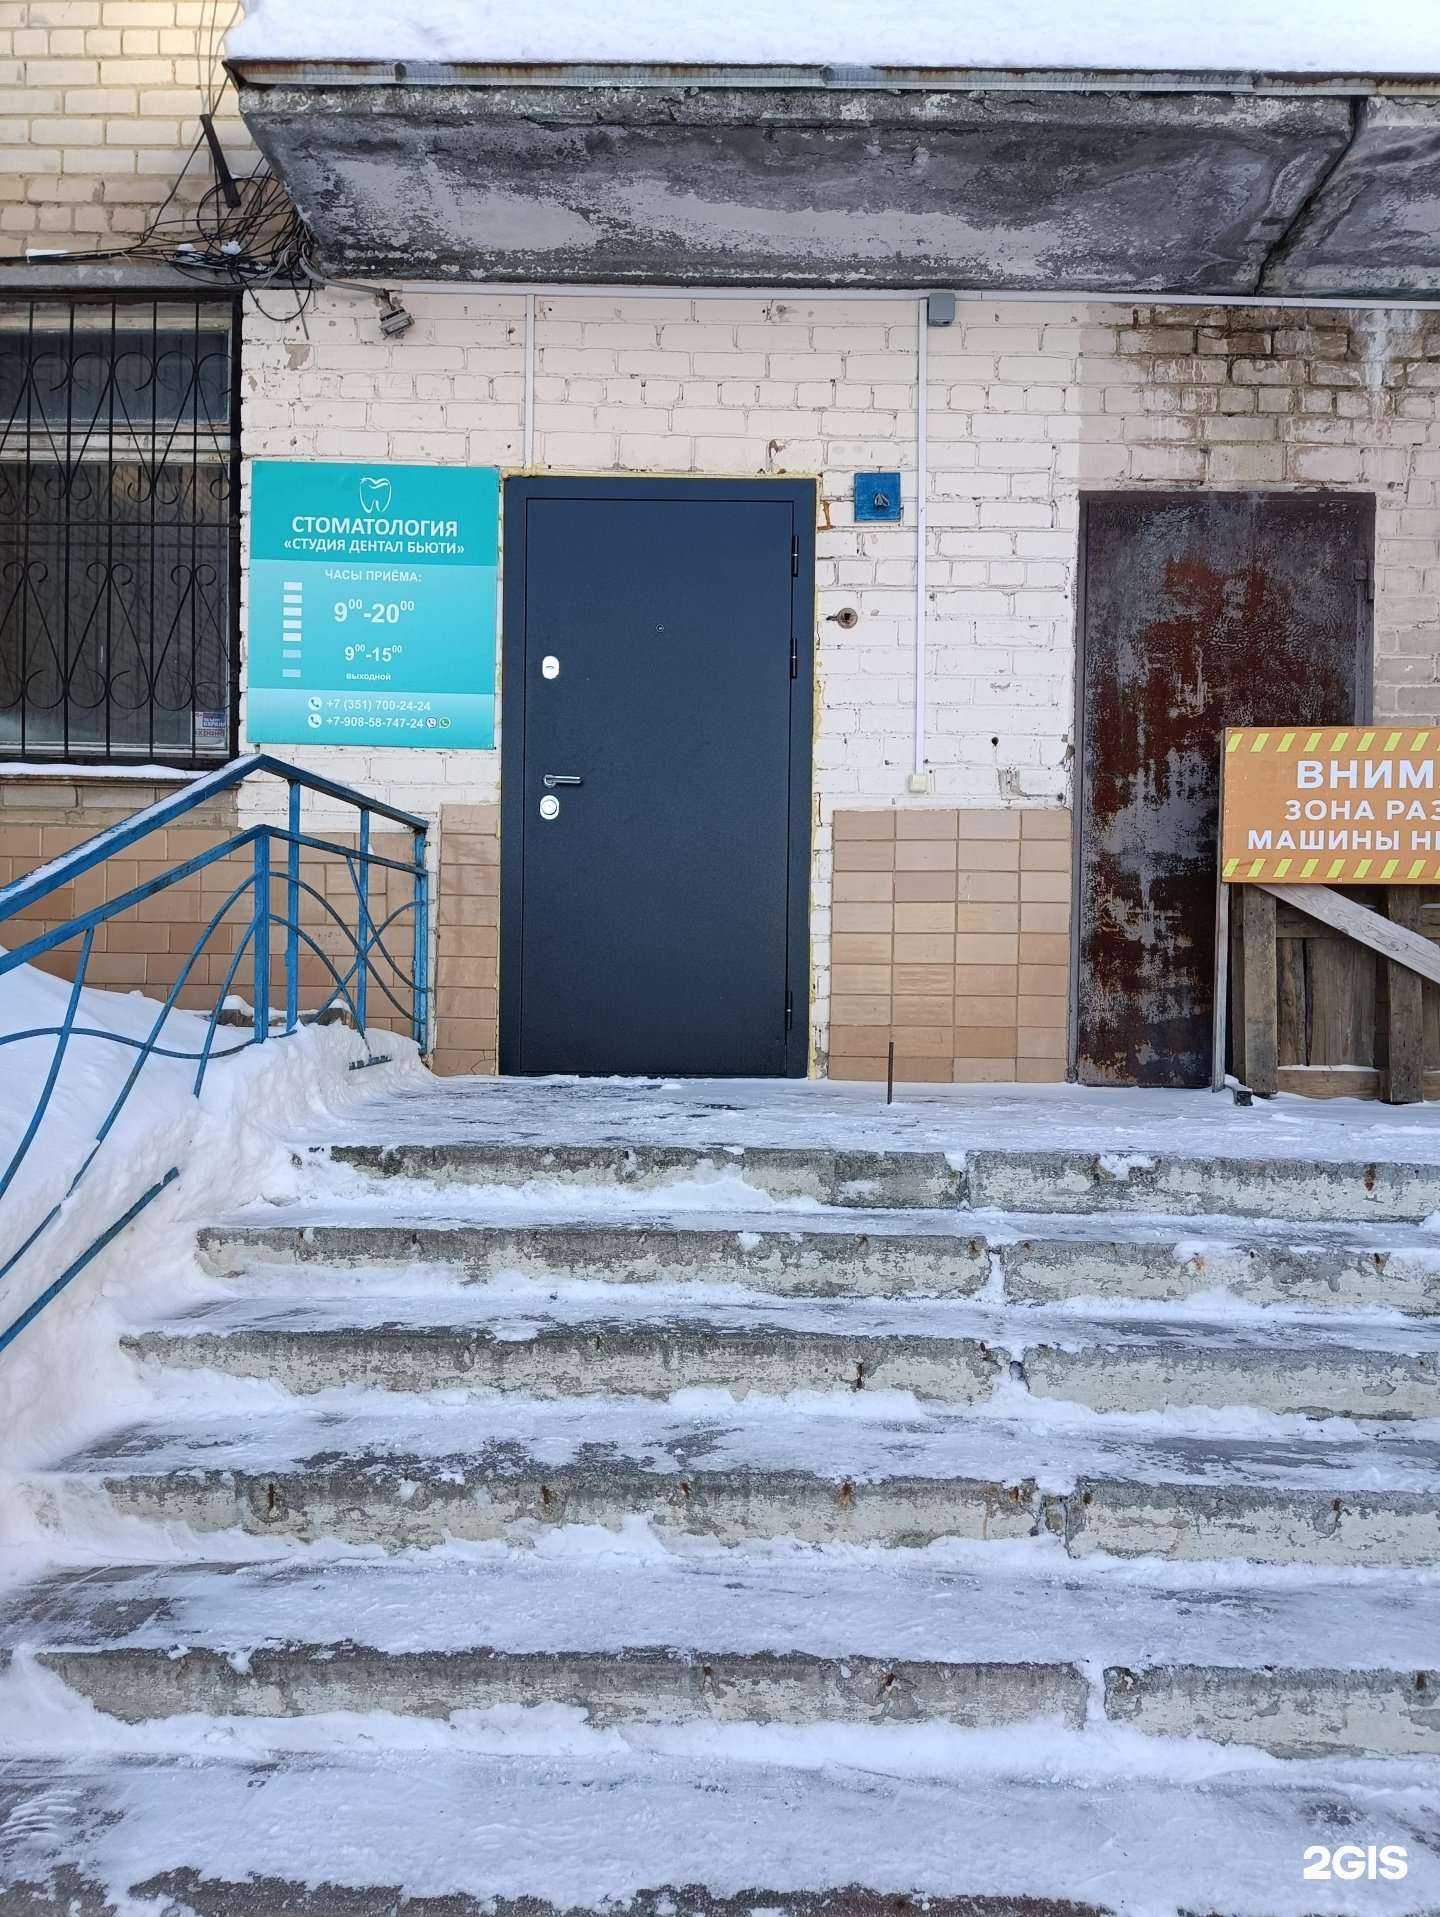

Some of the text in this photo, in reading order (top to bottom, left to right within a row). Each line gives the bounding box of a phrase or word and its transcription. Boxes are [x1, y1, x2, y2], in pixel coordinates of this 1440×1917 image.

[292, 516, 458, 537] СТОМАТОЛОГИЯ
[284, 537, 465, 555] «СТУДИЯ ДЕНТАЛ БЬЮТИ»
[325, 569, 422, 583] ЧАСЫ ПРИЁМА:
[346, 672, 392, 682] выходной
[326, 699, 431, 712] +7 (351) 700-24-24
[326, 717, 424, 729] +7-908-58-747-24
[1296, 759, 1434, 789] ВНИМ
[1284, 799, 1376, 821] ЗОНА
[1247, 829, 1400, 850] МАШИНЫ
